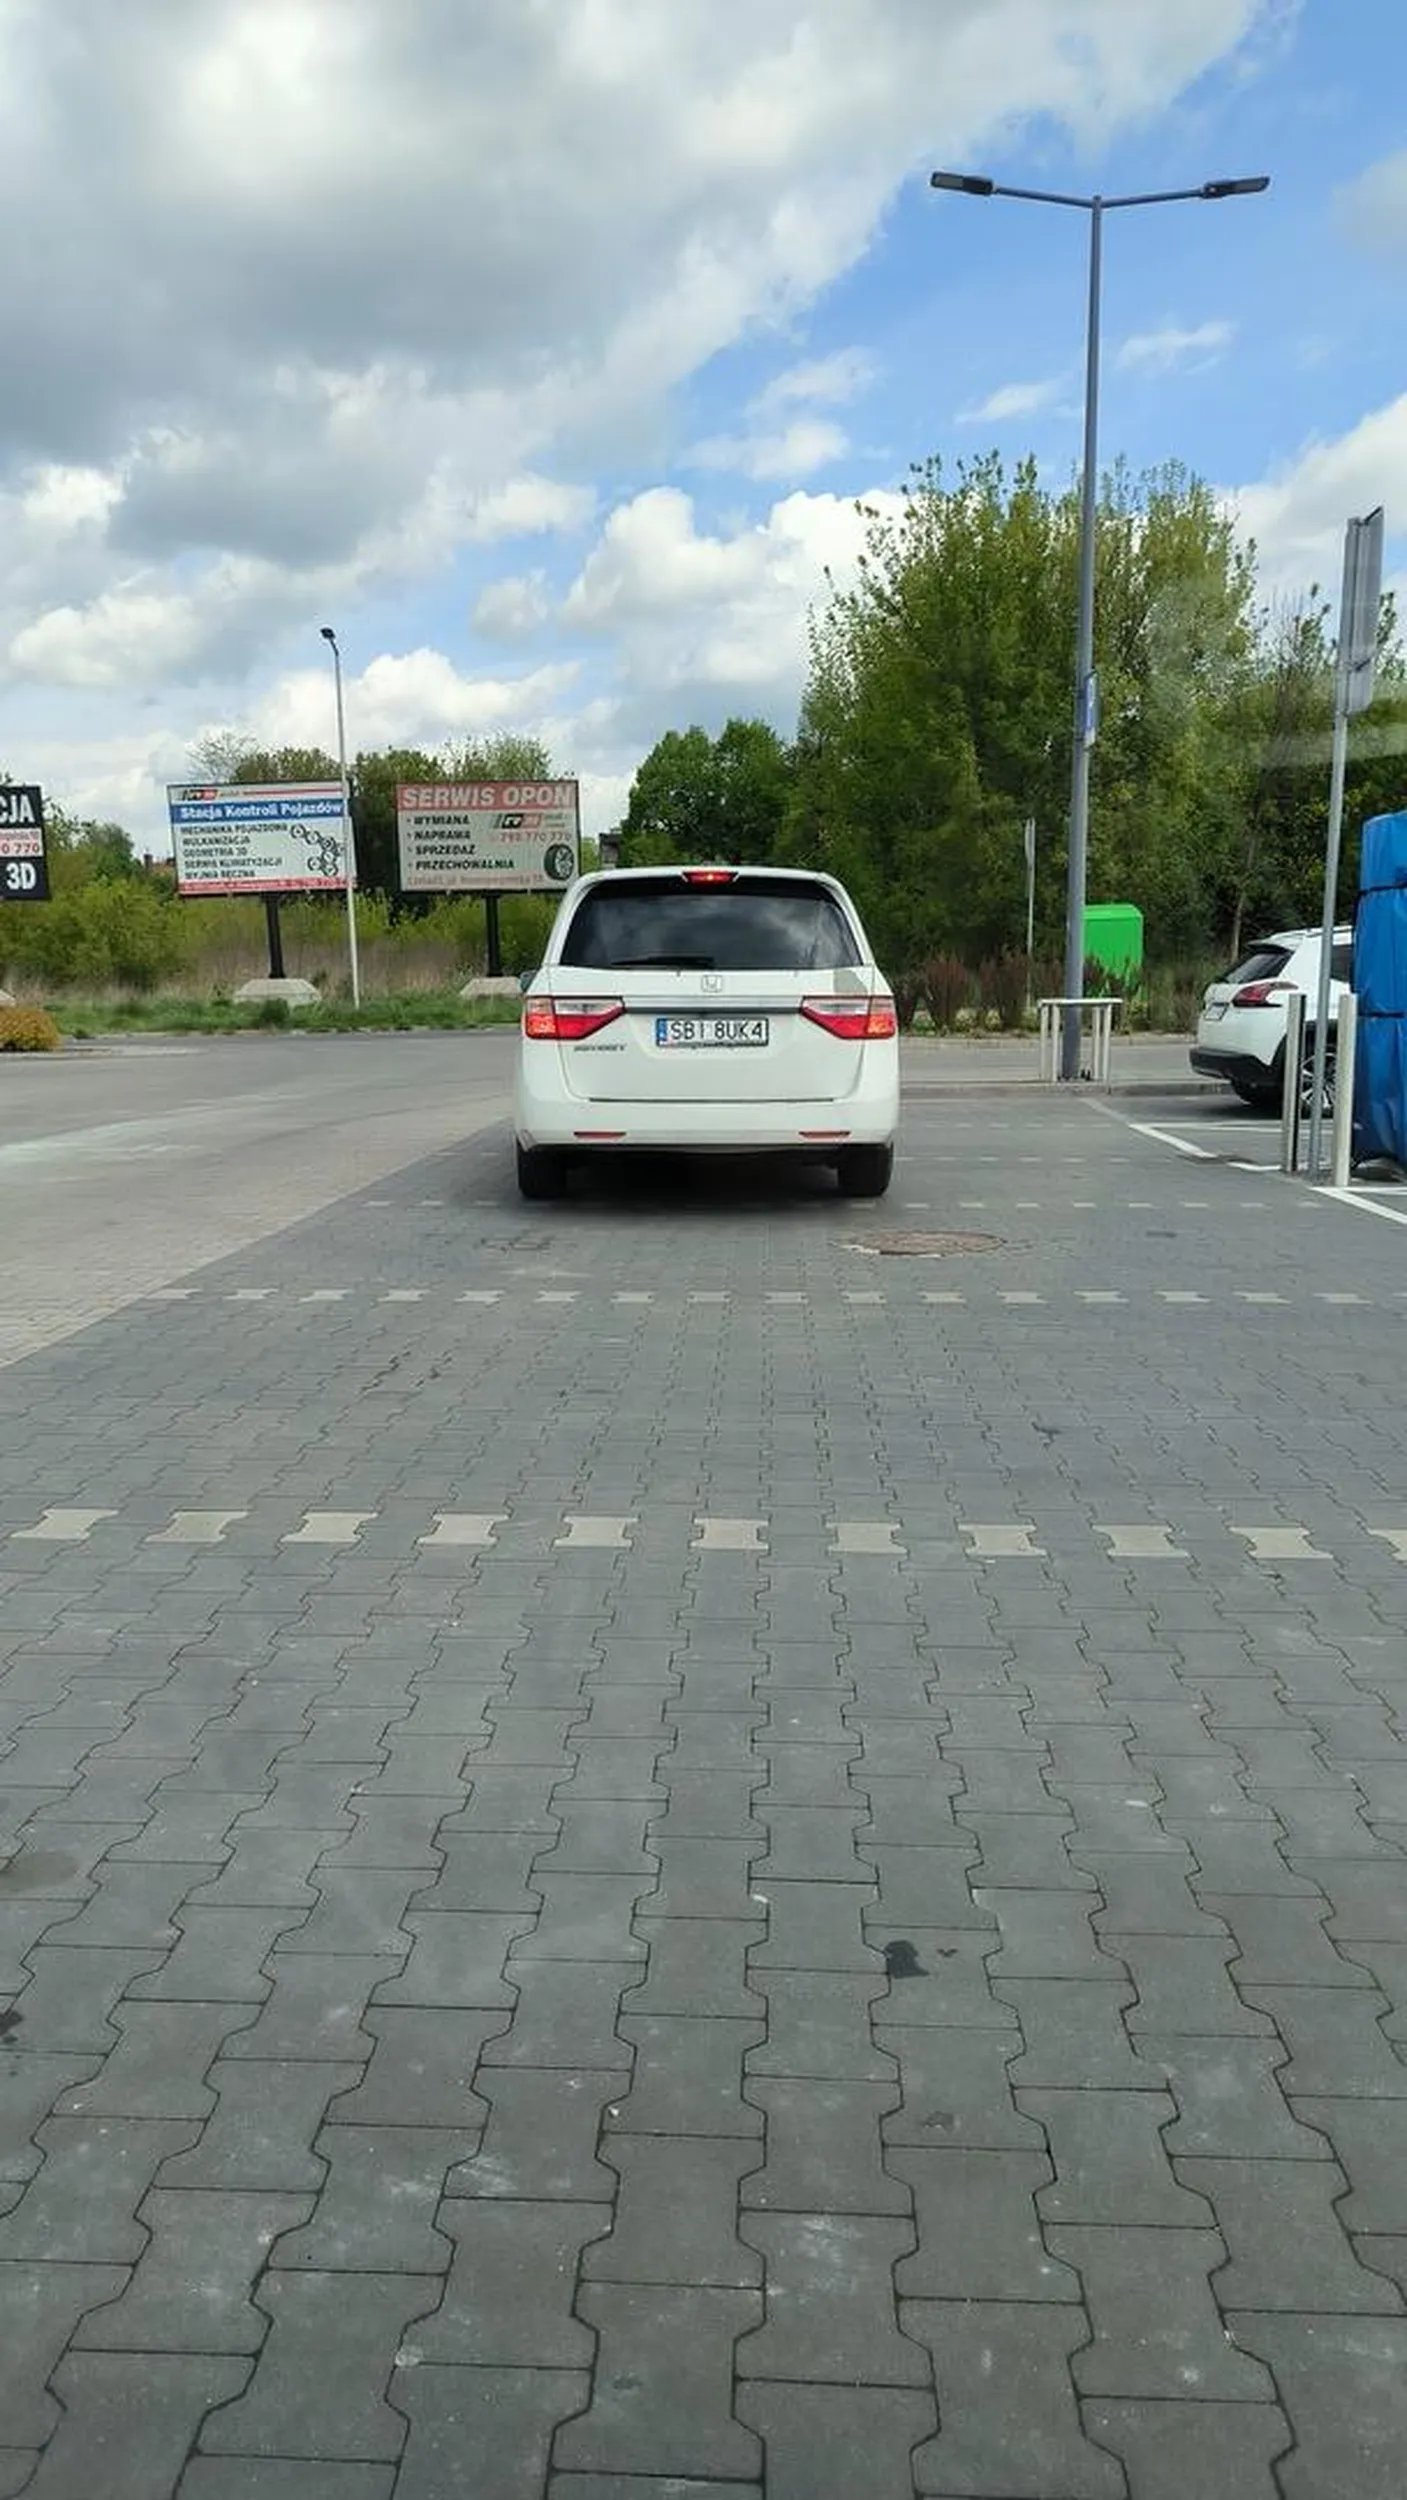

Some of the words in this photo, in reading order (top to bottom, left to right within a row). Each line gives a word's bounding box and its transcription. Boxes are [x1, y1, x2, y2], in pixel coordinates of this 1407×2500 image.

[403, 786, 496, 808] SERWIS
[503, 785, 571, 806] OPON
[180, 805, 222, 820] Stacja
[224, 804, 278, 818] Kontroli
[281, 801, 342, 817] Pojazdów
[414, 814, 470, 825] WYMIANA
[183, 836, 250, 846] WULKANIZACJA
[414, 830, 471, 841] NAPRAWA
[415, 859, 515, 871] PRZECHOWALNIA
[6, 862, 37, 890] 3D
